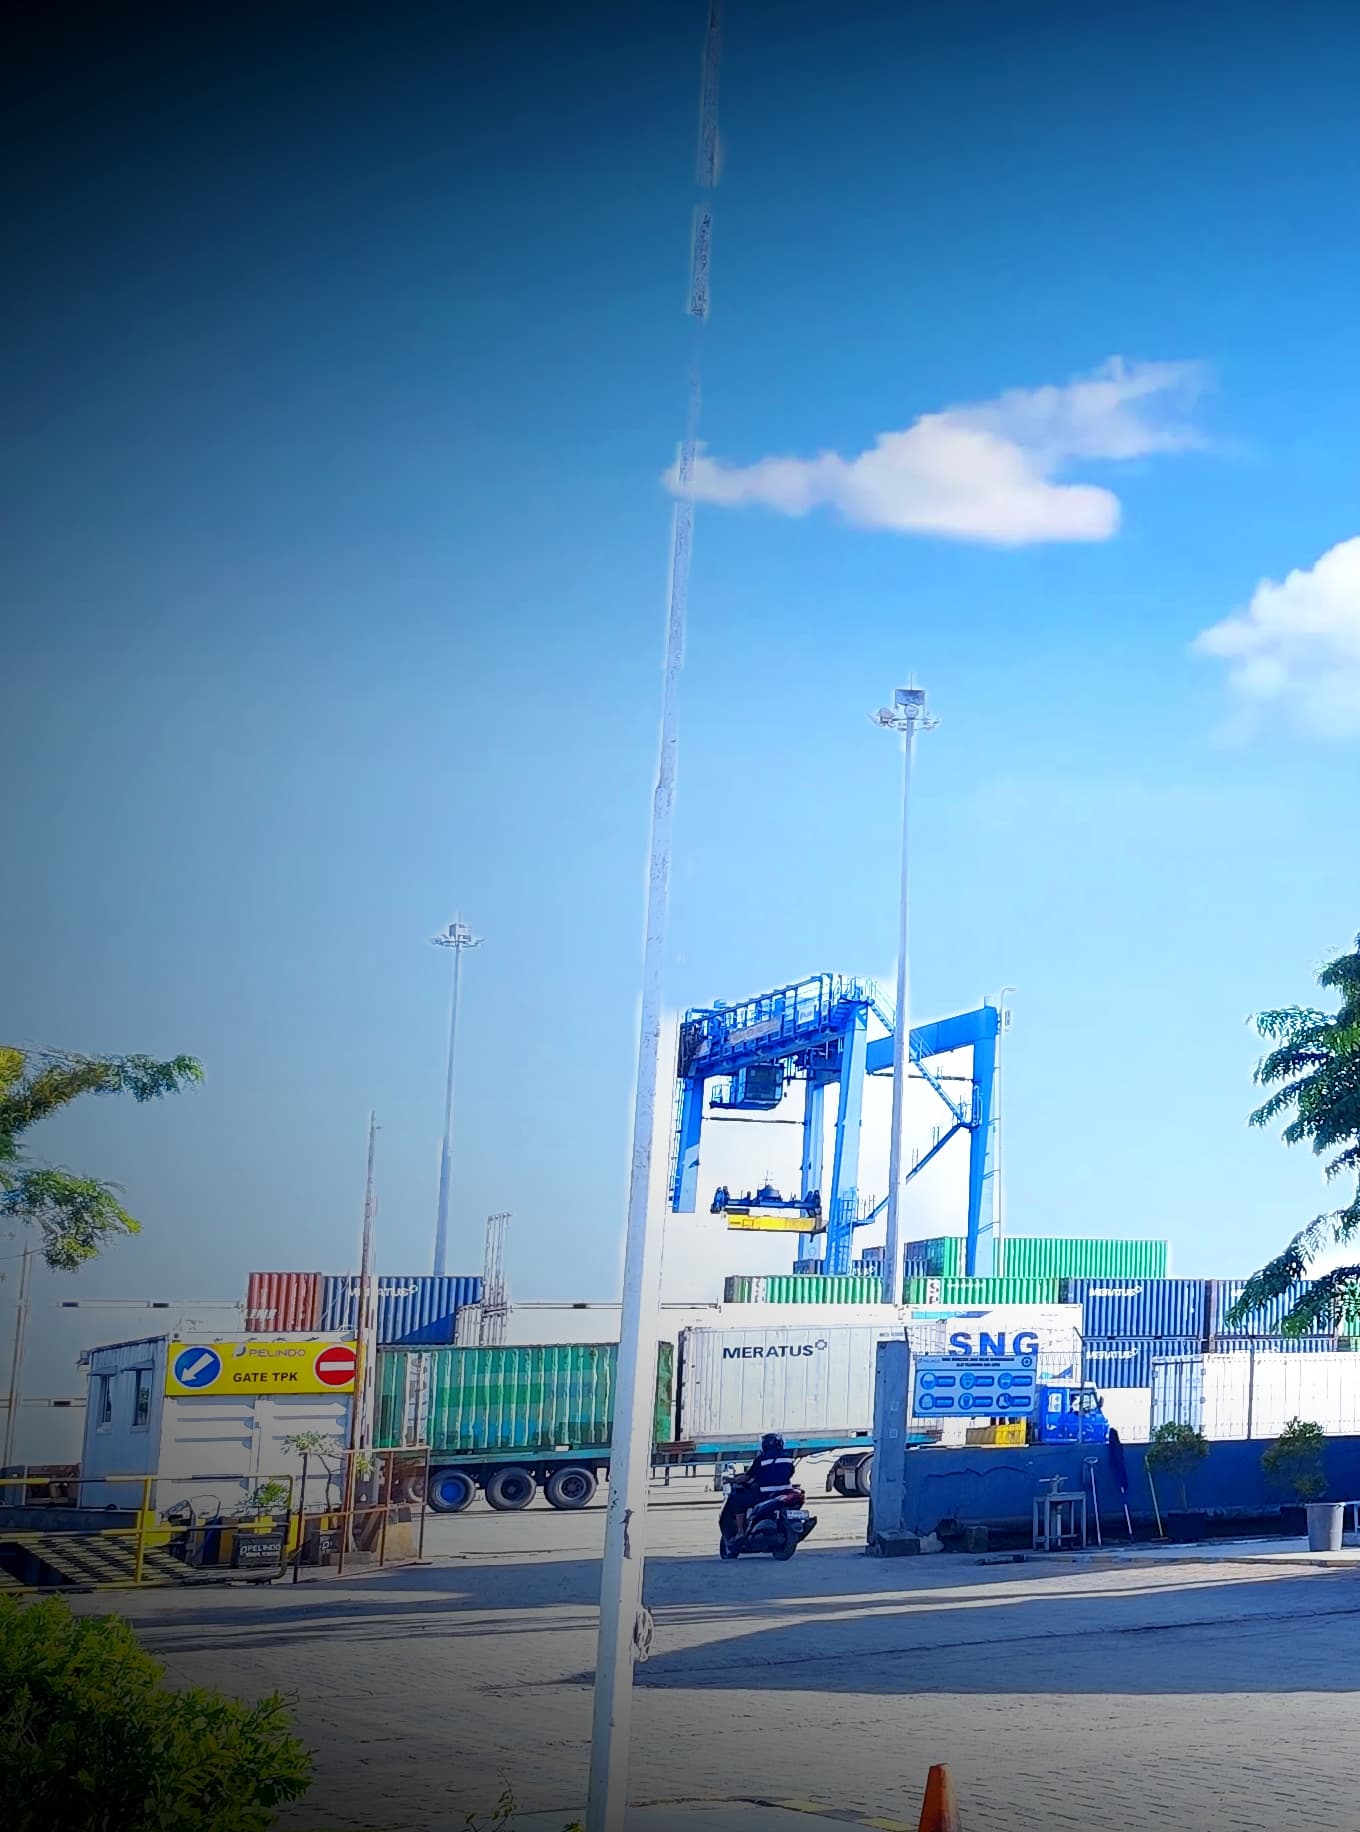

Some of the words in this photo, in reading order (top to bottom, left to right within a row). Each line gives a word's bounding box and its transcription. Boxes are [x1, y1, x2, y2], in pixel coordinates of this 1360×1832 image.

[348, 1287, 409, 1297] MATUS
[949, 1331, 1040, 1356] SNG
[249, 1348, 306, 1358] PELINDO
[723, 1344, 814, 1359] MERATUS
[233, 1372, 268, 1383] GATE
[271, 1371, 299, 1383] TPK
